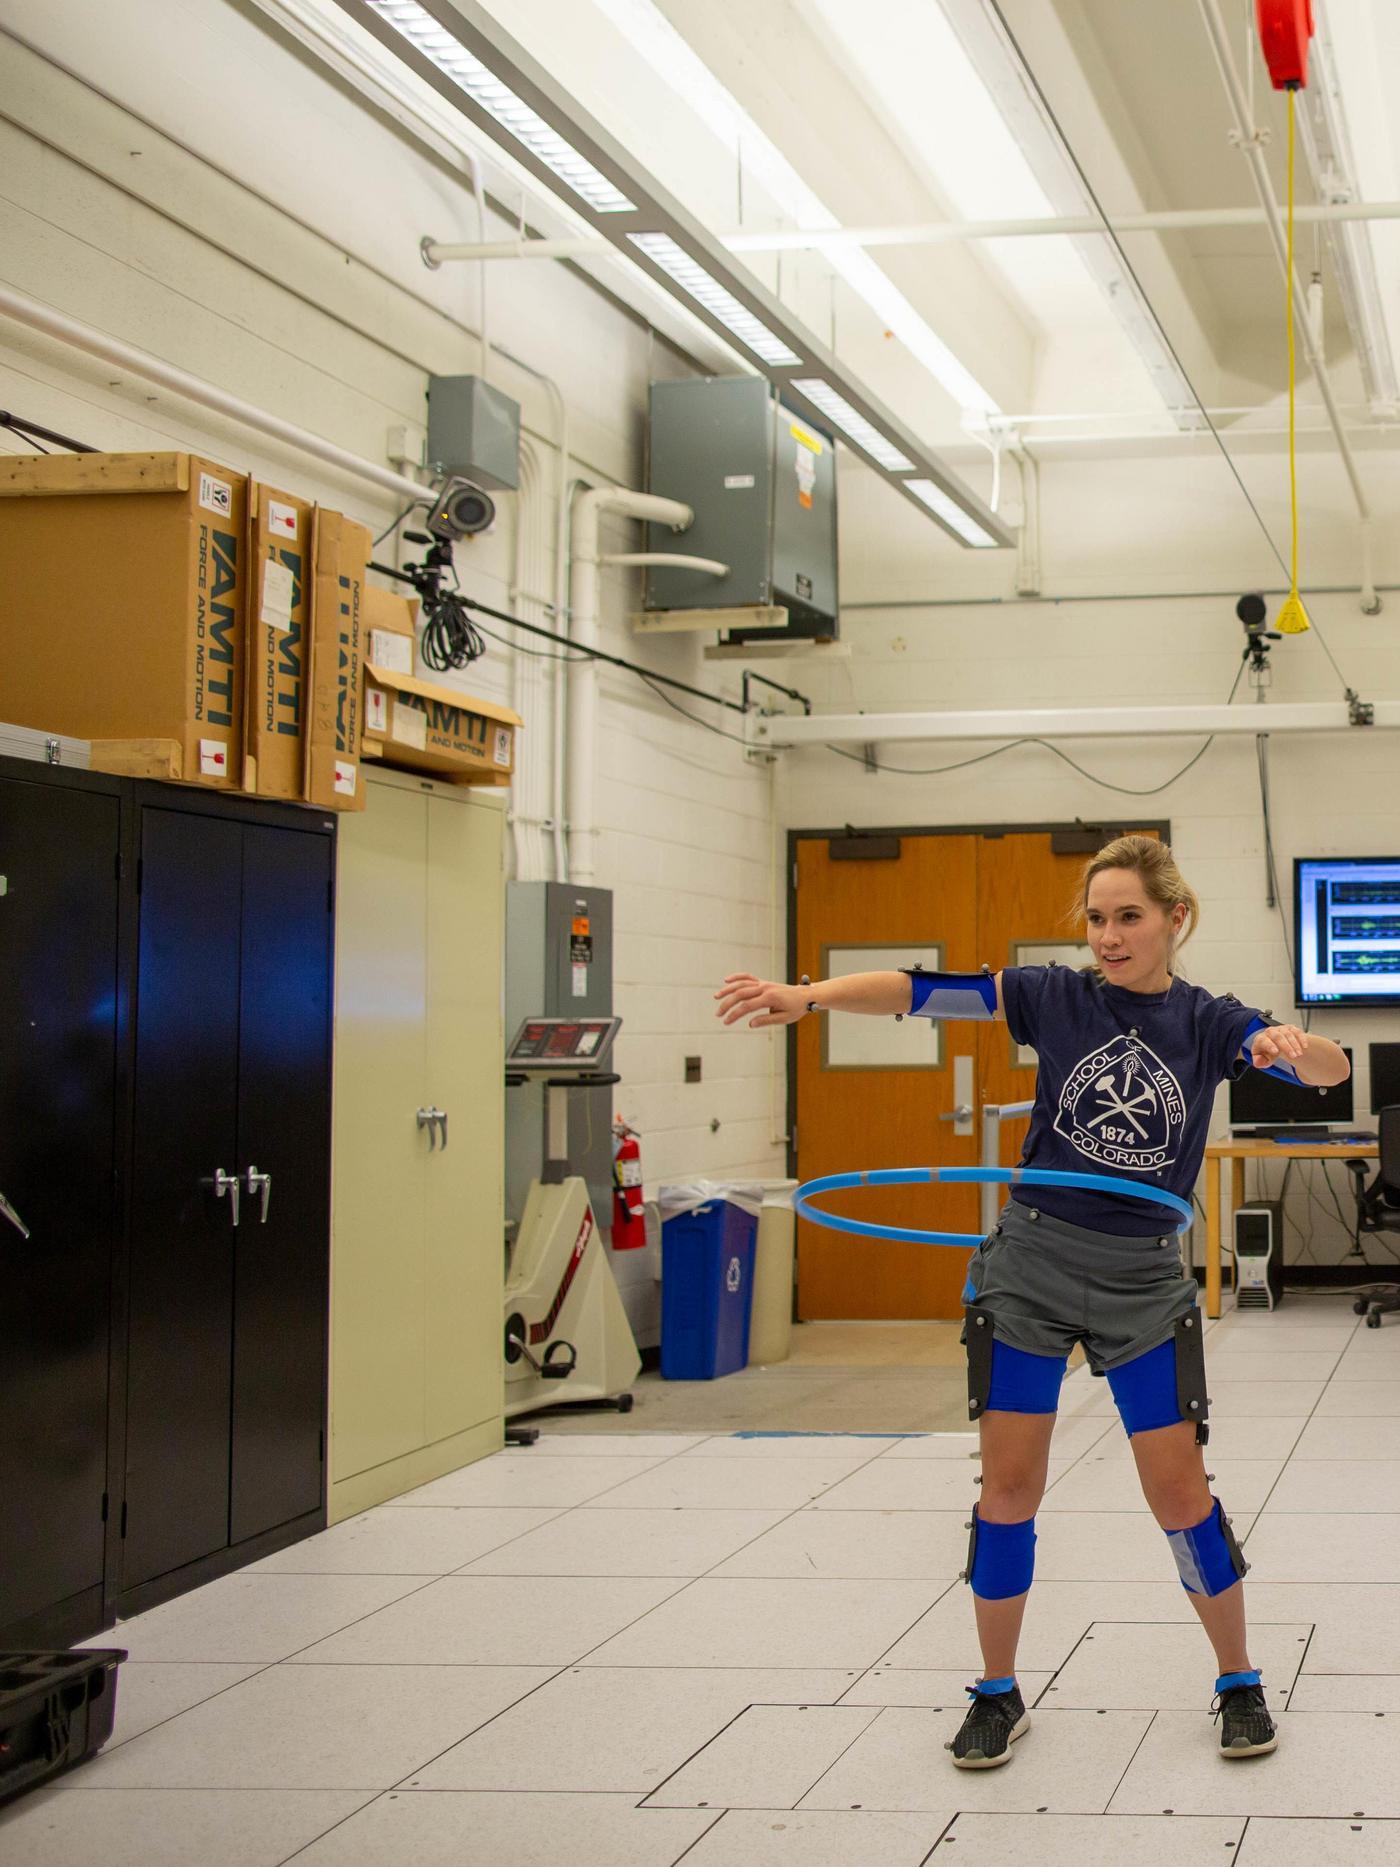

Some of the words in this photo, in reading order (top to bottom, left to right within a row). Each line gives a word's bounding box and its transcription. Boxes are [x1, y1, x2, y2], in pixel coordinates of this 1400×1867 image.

[198, 524, 208, 589] FORCE
[198, 595, 206, 638] AND
[207, 529, 238, 728] AMTI
[267, 626, 276, 650] ND
[195, 644, 204, 720] MOTION
[266, 659, 275, 732] MOTION
[348, 697, 356, 754] FORCE
[352, 581, 360, 648] MOTION
[431, 736, 450, 748] AND
[453, 740, 486, 758] MOTION
[1062, 1052, 1118, 1110] SCHOOL
[1152, 1070, 1182, 1125] MINES
[1070, 1130, 1166, 1166] COLORADO
[1100, 1124, 1136, 1145] 1874
